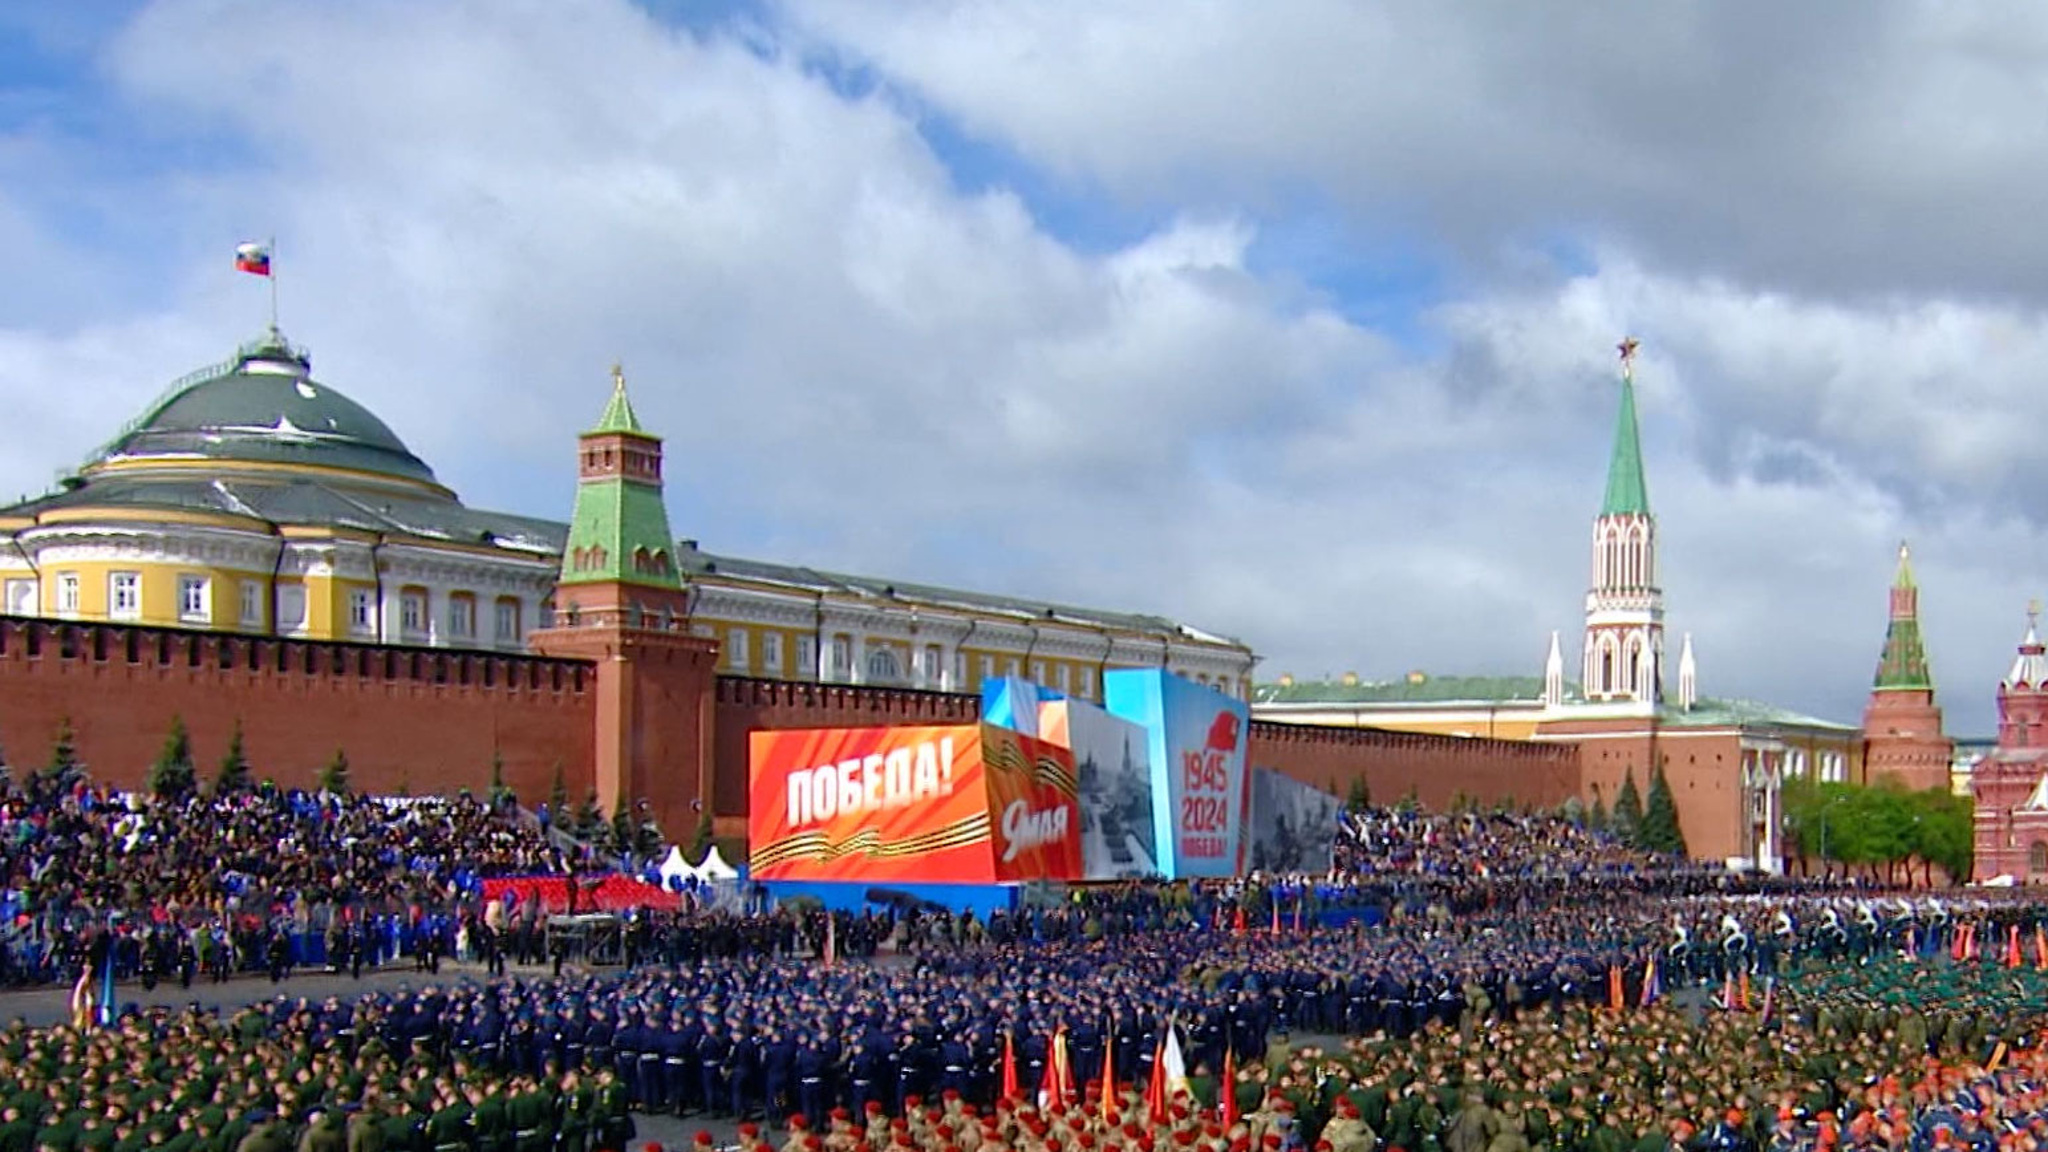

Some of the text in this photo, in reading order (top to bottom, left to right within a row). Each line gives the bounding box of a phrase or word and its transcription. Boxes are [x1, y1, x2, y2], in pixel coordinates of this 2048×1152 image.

[787, 736, 953, 827] ПОБЕДА!
[1182, 752, 1227, 791] 1945
[1182, 797, 1227, 832] 2024
